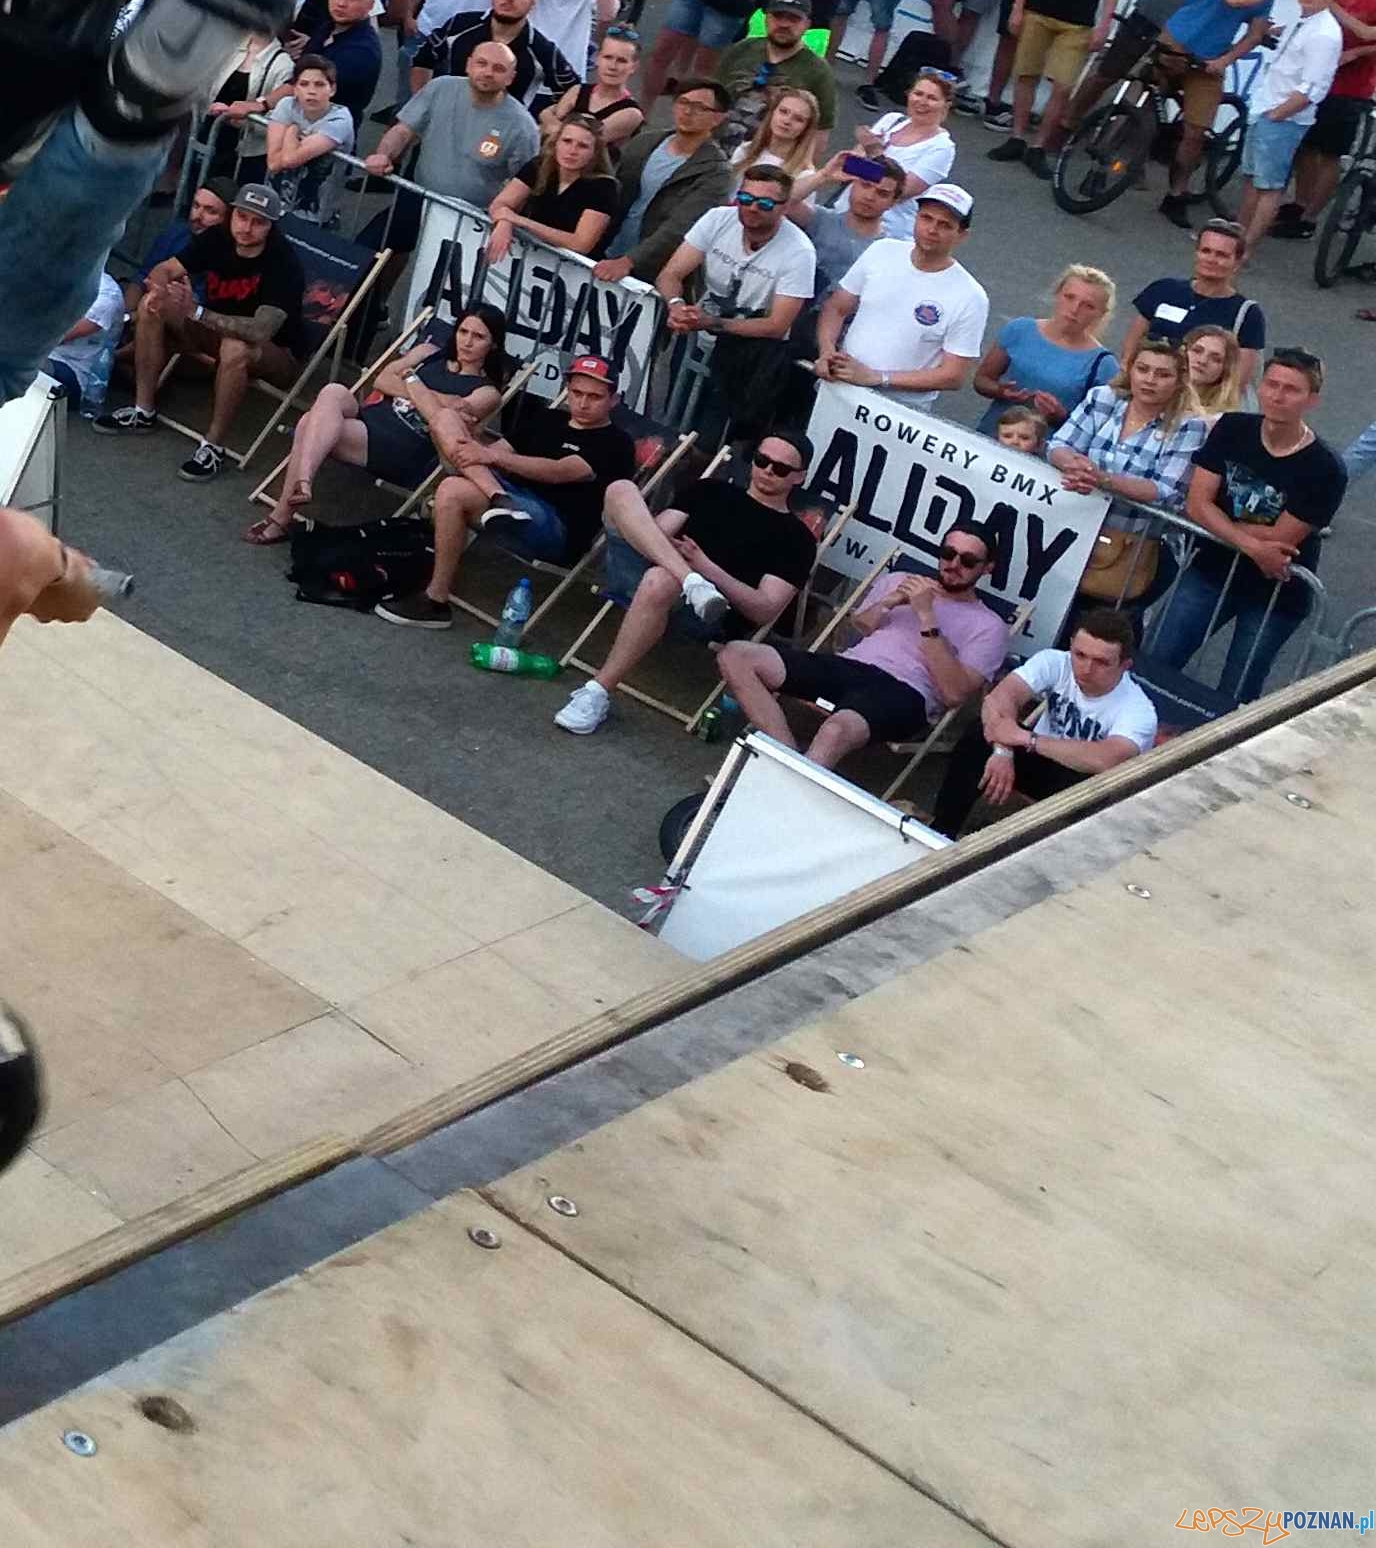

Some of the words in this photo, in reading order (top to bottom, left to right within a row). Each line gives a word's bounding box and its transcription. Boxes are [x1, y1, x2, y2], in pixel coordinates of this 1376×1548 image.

[810, 426, 1080, 602] ALLDAY
[854, 404, 980, 470] ROWERY
[989, 463, 1059, 506] BMX
